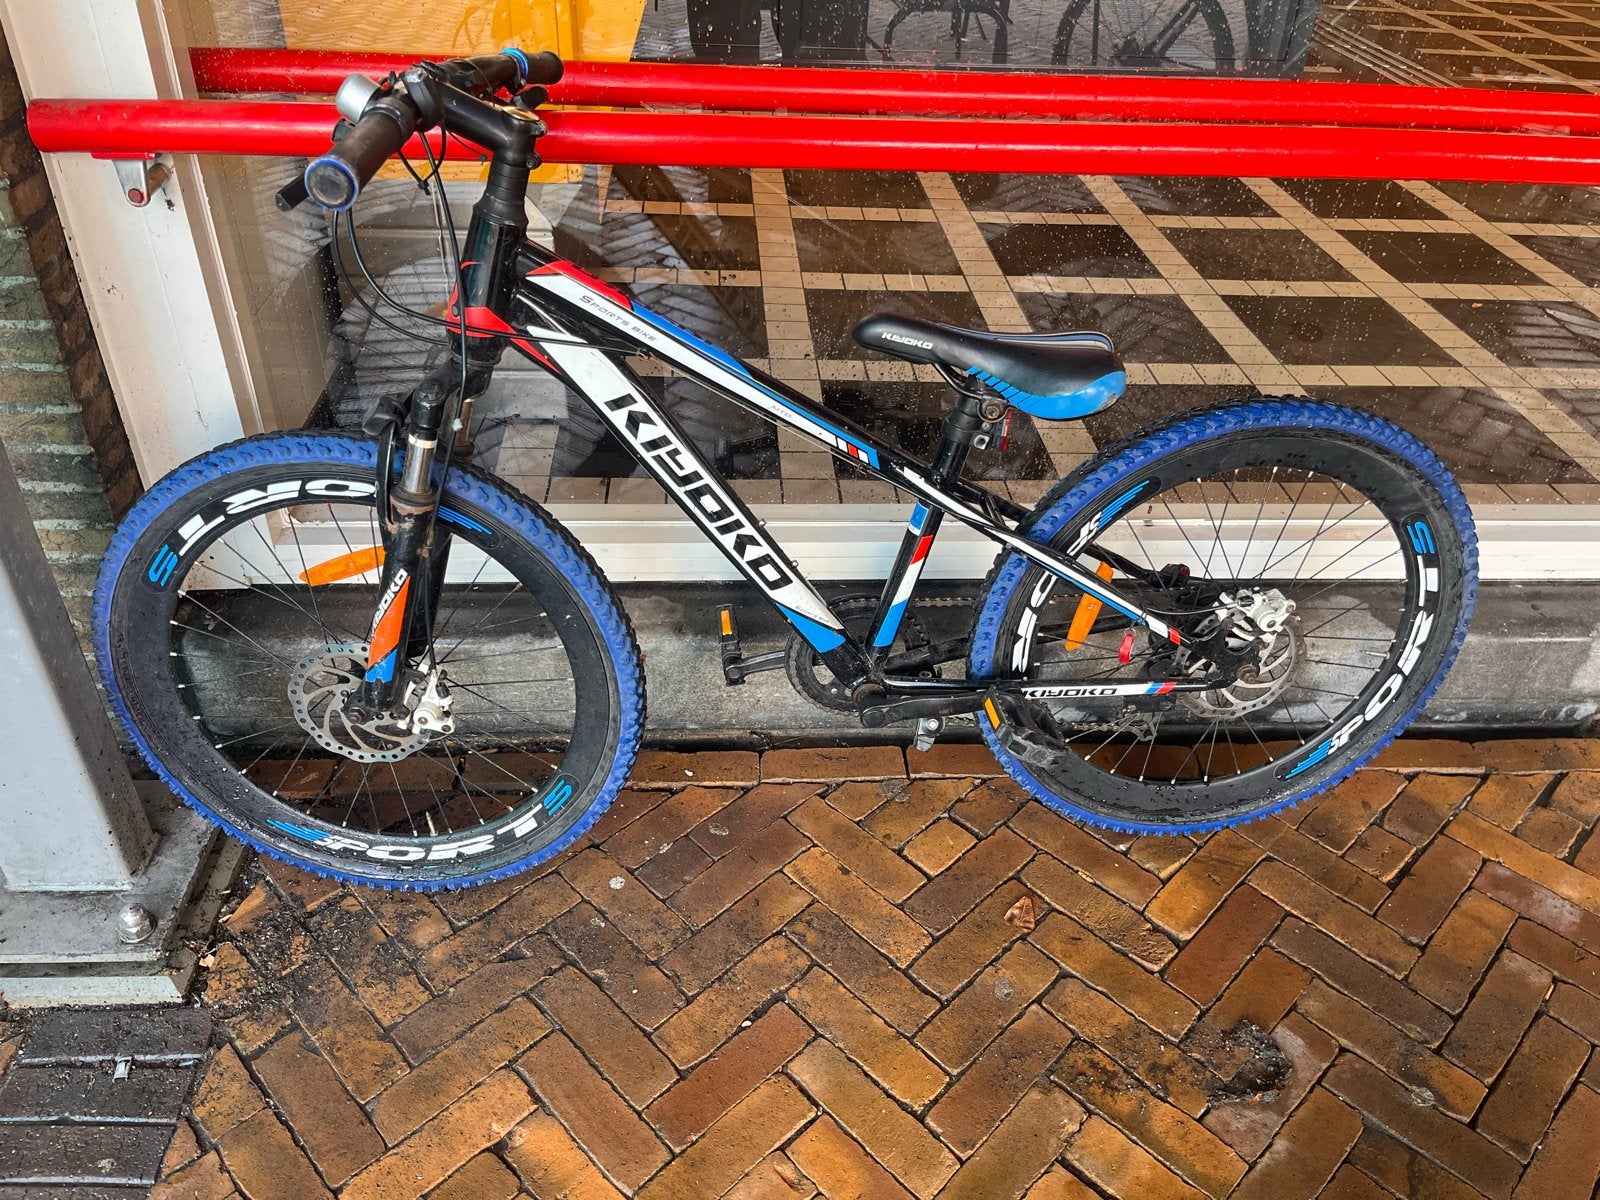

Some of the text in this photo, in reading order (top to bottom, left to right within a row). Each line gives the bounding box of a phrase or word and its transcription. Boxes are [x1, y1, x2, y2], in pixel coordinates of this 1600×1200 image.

[579, 295, 658, 341] SPORTS BIKE
[881, 332, 934, 350] KIYOKO
[149, 479, 377, 586] ORTS
[603, 393, 794, 590] KIYOKO
[1328, 521, 1439, 755] SPORTS
[311, 779, 573, 861] SPORTS
